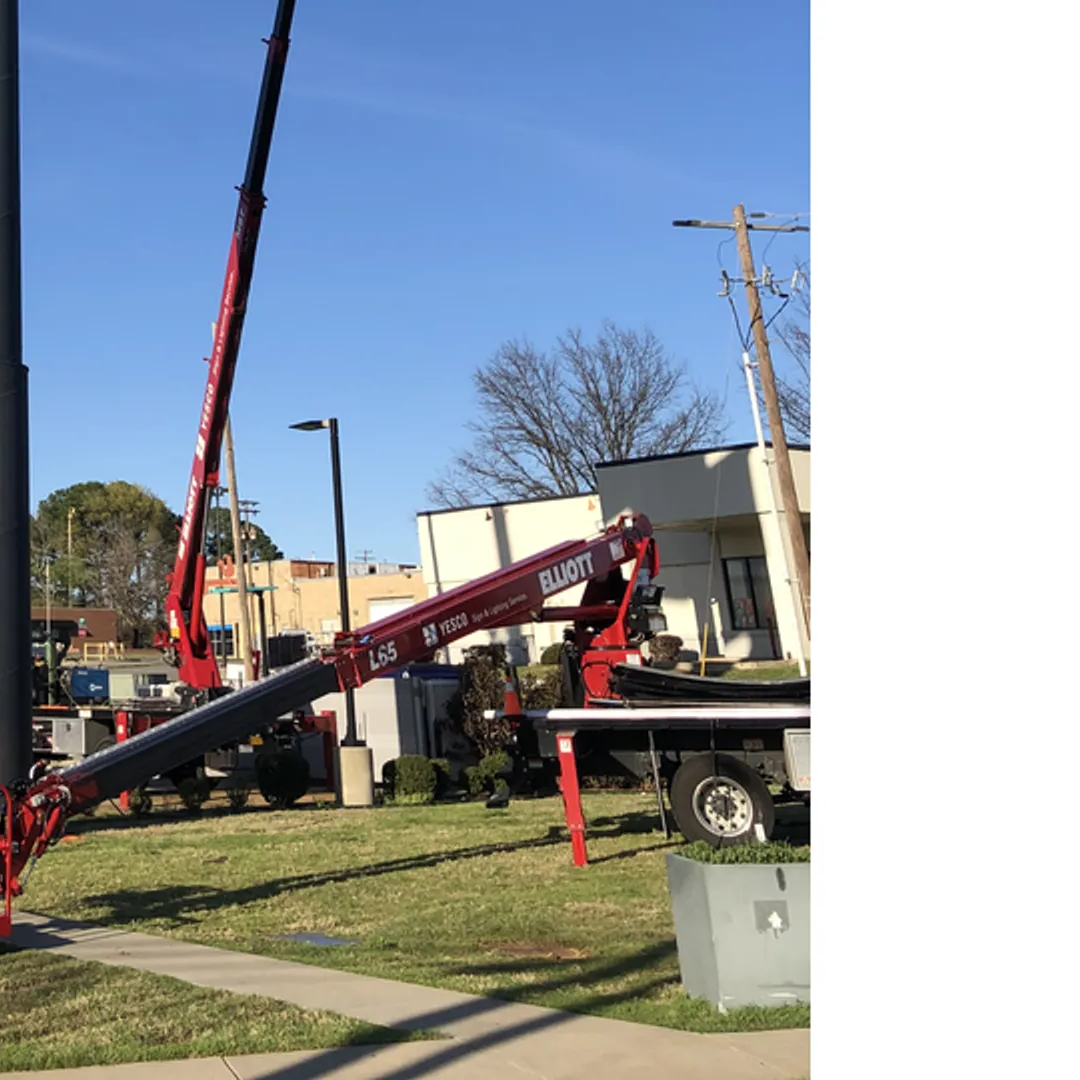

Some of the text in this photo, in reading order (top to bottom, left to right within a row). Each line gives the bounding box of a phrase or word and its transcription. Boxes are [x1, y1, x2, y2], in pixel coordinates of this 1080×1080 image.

[368, 640, 398, 671] L65
[439, 612, 469, 636] YESCO
[538, 551, 594, 595] ELLIOTT
